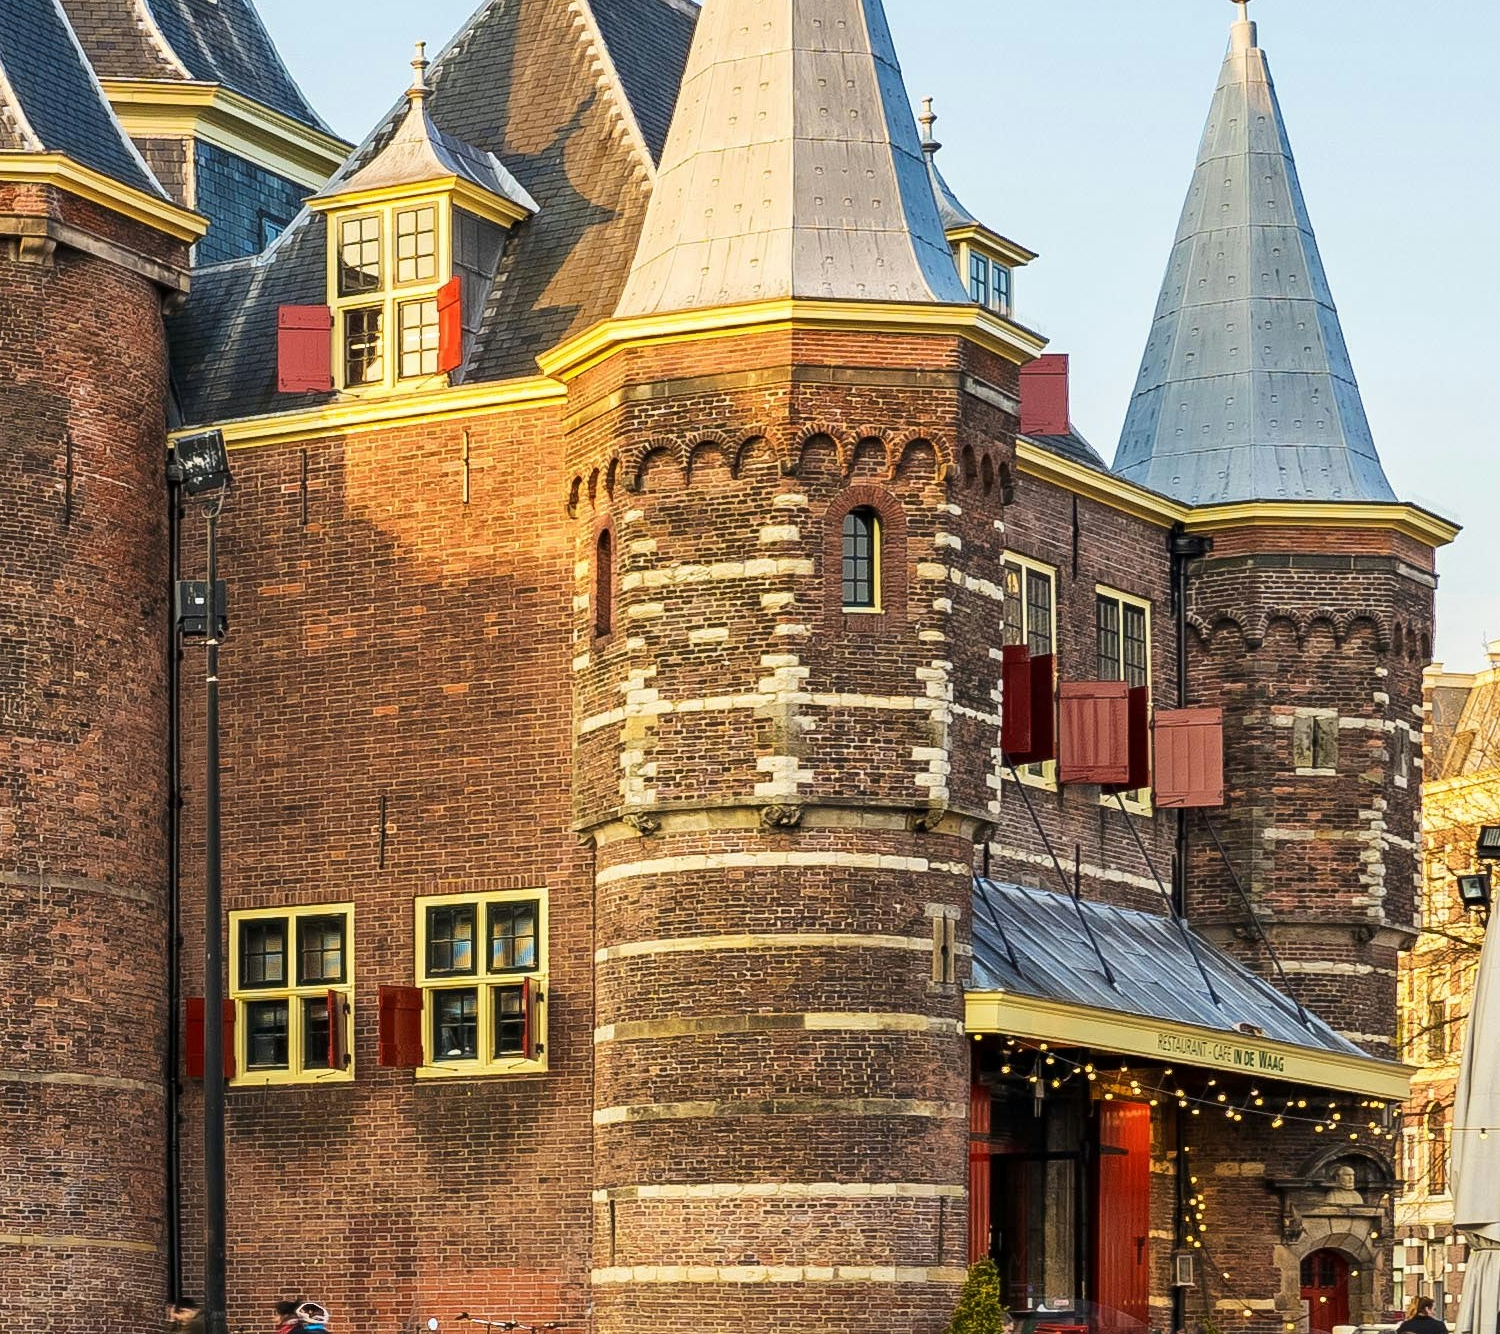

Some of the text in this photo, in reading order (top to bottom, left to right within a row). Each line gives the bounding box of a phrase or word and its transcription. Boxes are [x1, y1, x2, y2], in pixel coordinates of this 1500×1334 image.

[1158, 1034, 1207, 1057] RESTAURANT
[1233, 1049, 1242, 1065] IN
[1244, 1050, 1255, 1067] DE
